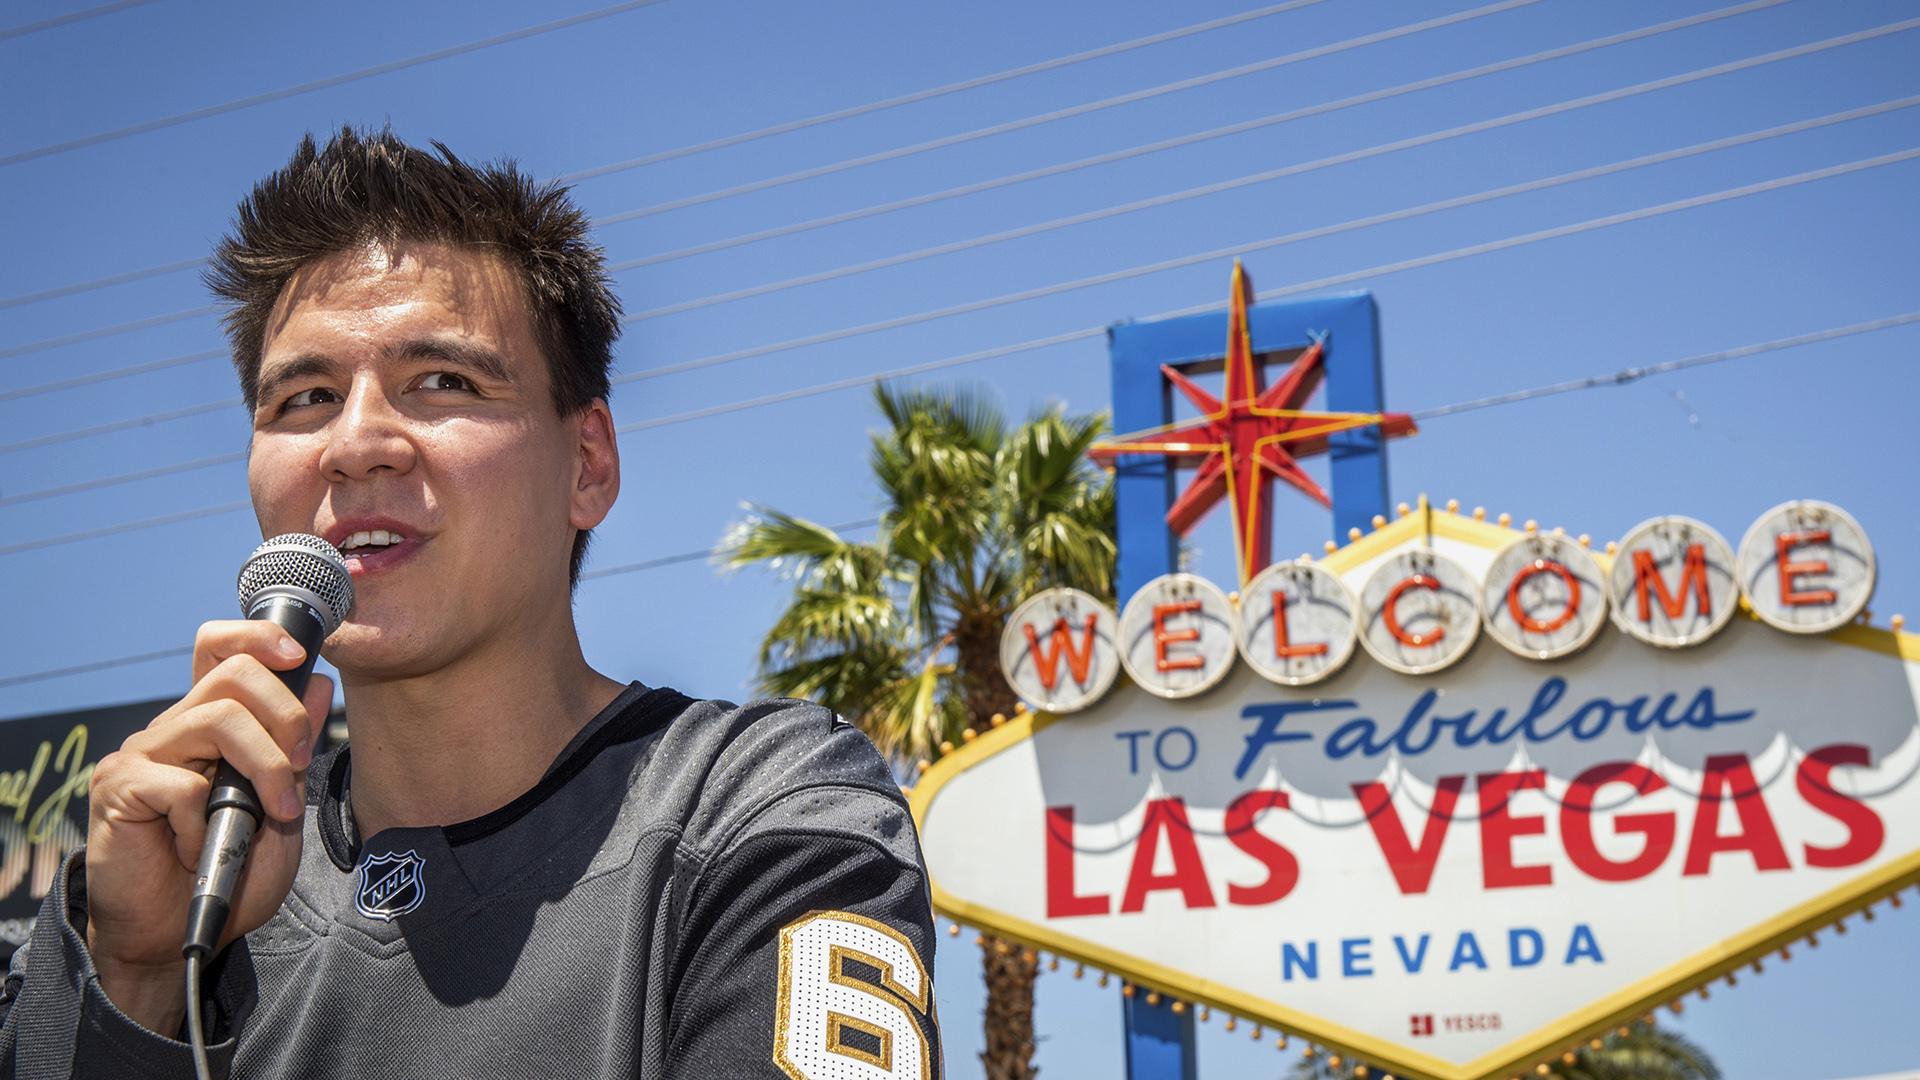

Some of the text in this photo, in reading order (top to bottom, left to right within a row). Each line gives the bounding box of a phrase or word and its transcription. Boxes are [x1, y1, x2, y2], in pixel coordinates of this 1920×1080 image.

[1023, 530, 1837, 690] WELCOME
[1116, 677, 1755, 780] TO Fabulous
[1045, 743, 1885, 919] LAS VEGAS
[371, 868, 411, 906] NHL
[1281, 924, 1604, 981] NEVADA
